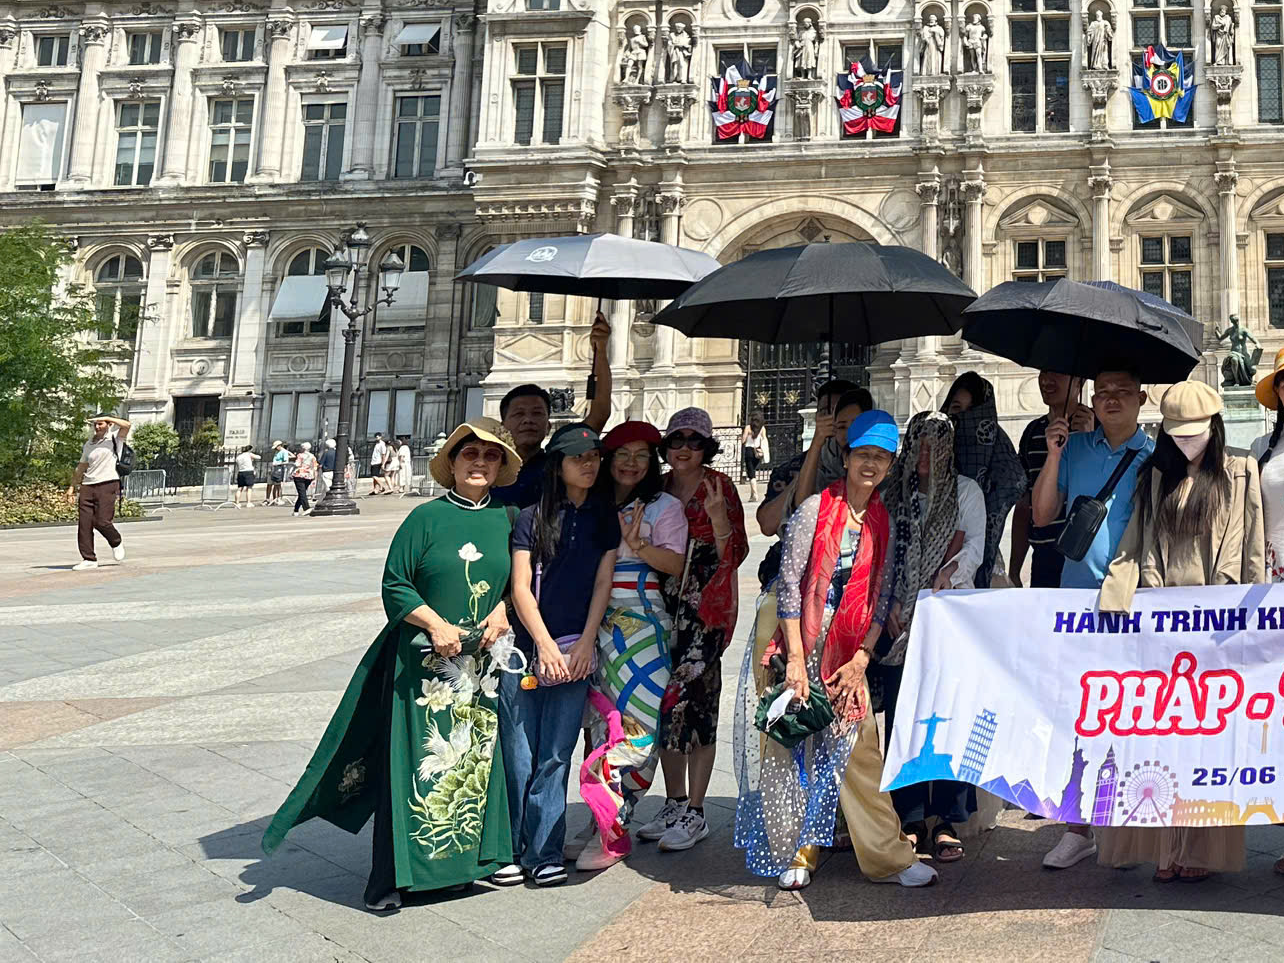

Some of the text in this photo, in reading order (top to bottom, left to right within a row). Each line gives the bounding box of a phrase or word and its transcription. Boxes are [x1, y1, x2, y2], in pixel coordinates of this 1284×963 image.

[1053, 608, 1143, 634] HÀNH
[1151, 605, 1248, 633] TRÌNH
[1191, 766, 1276, 787] 25/06
